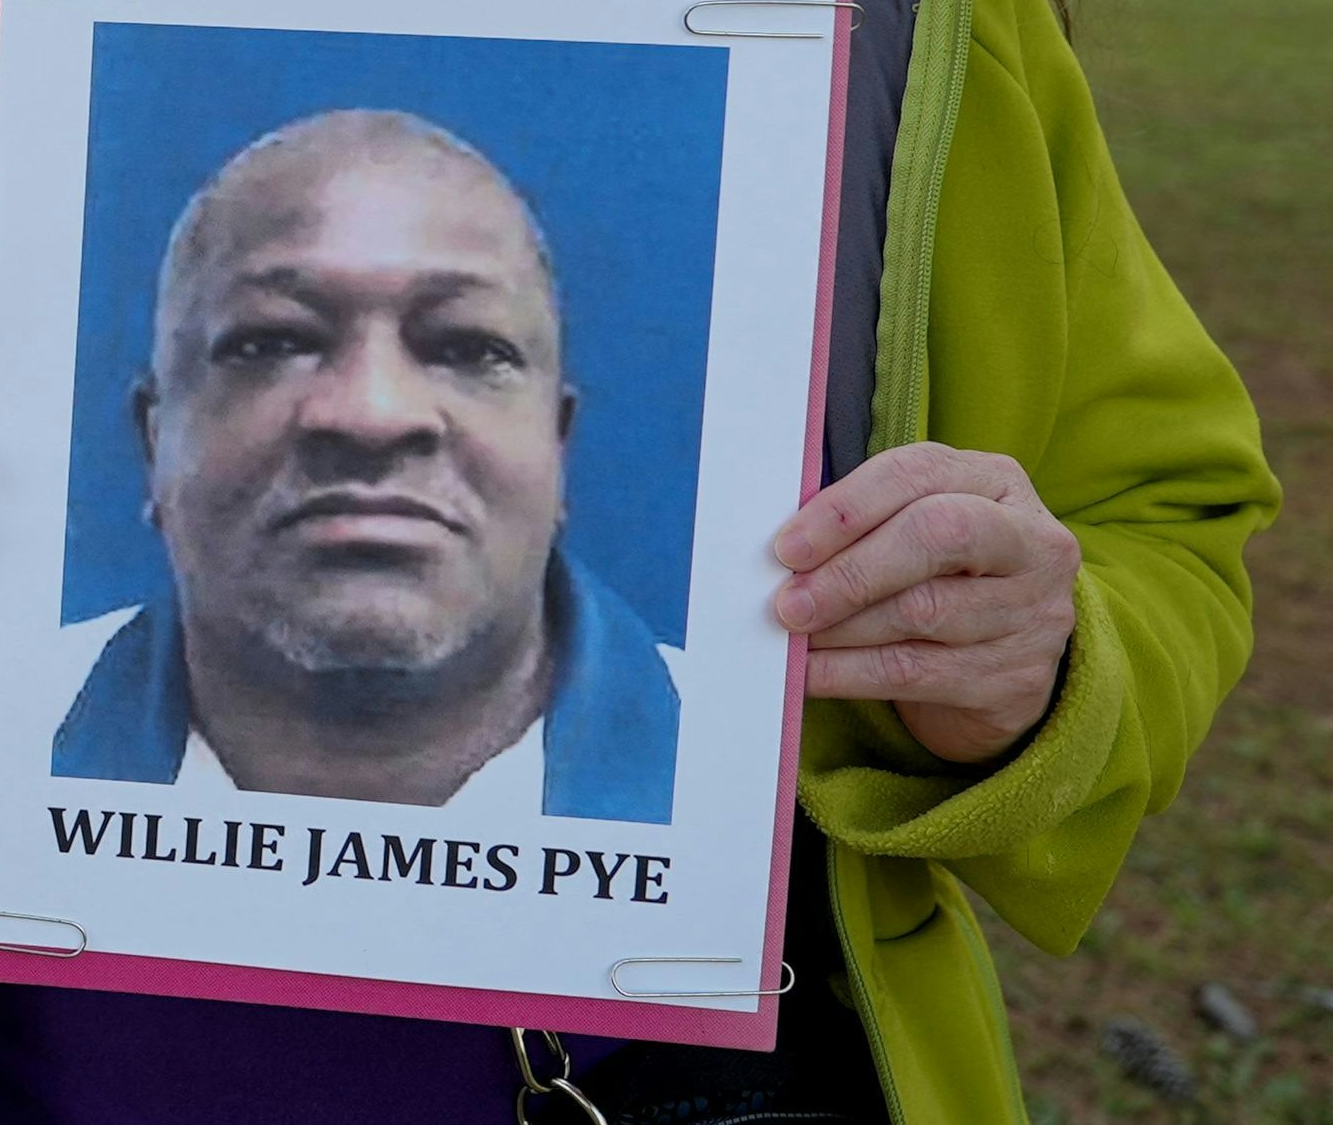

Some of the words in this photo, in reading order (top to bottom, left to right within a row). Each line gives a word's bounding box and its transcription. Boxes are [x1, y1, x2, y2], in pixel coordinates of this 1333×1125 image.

[46, 806, 286, 871] WILLIE
[302, 826, 520, 892] JAMES
[536, 846, 672, 905] PYE
